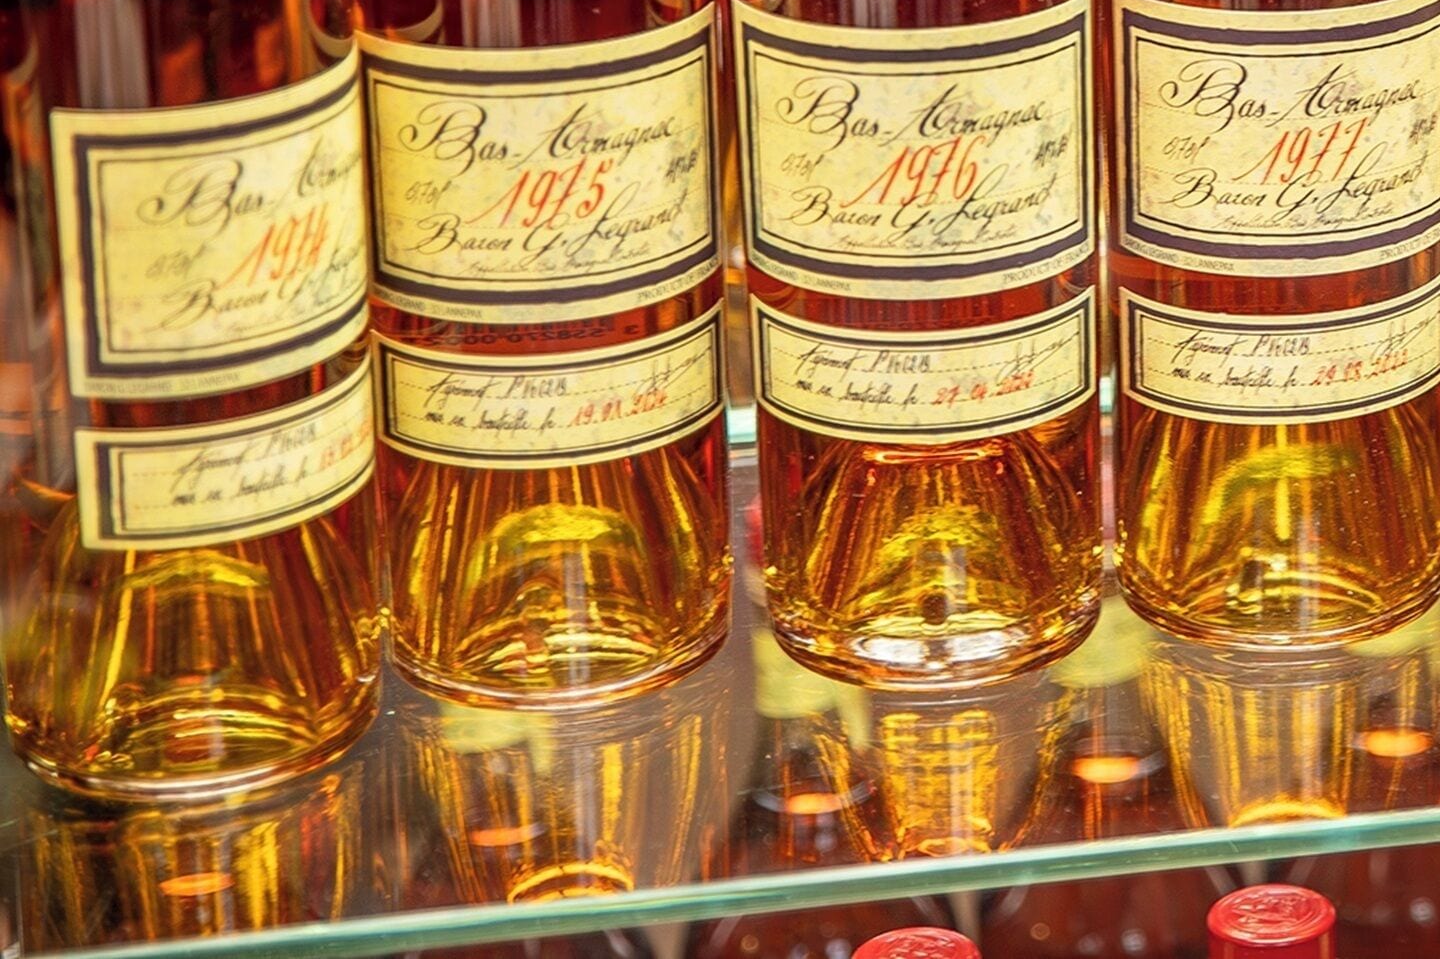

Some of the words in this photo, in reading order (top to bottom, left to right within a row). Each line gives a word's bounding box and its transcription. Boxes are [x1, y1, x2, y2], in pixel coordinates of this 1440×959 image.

[840, 135, 986, 208] 1976
[1232, 116, 1369, 185] 1977
[465, 156, 613, 229] 1975
[781, 186, 880, 225] Baron
[1159, 167, 1265, 208] Baron
[404, 213, 511, 254] Baron
